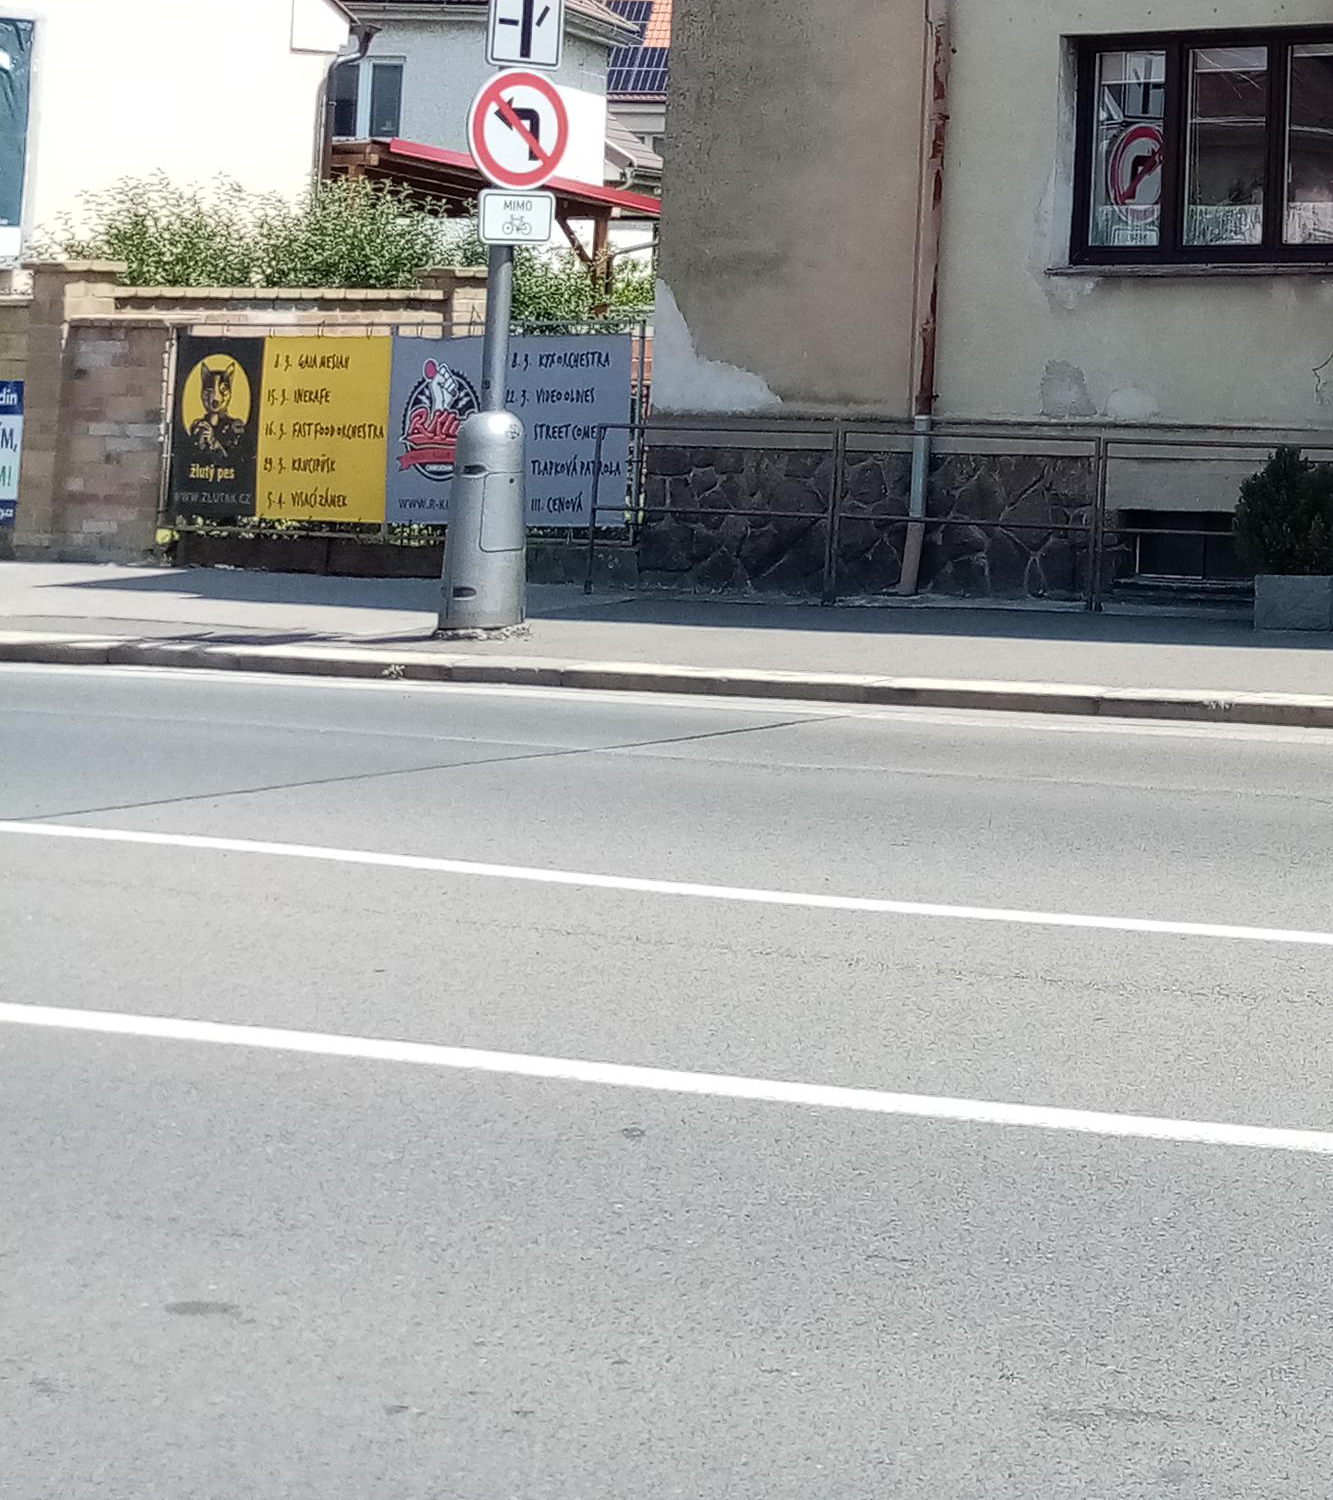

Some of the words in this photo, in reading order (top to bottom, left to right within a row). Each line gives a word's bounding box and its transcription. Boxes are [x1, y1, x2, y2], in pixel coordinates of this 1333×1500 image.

[503, 200, 533, 212] MIMO
[536, 388, 563, 404] VIDEO
[564, 387, 595, 404] OLDIES
[534, 423, 571, 440] STREET
[572, 425, 608, 441] COMEY
[188, 463, 215, 483] žlutý
[217, 467, 235, 483] pes
[531, 454, 578, 477] TLAPKOVÁ
[546, 492, 583, 514] CENOVÁ
